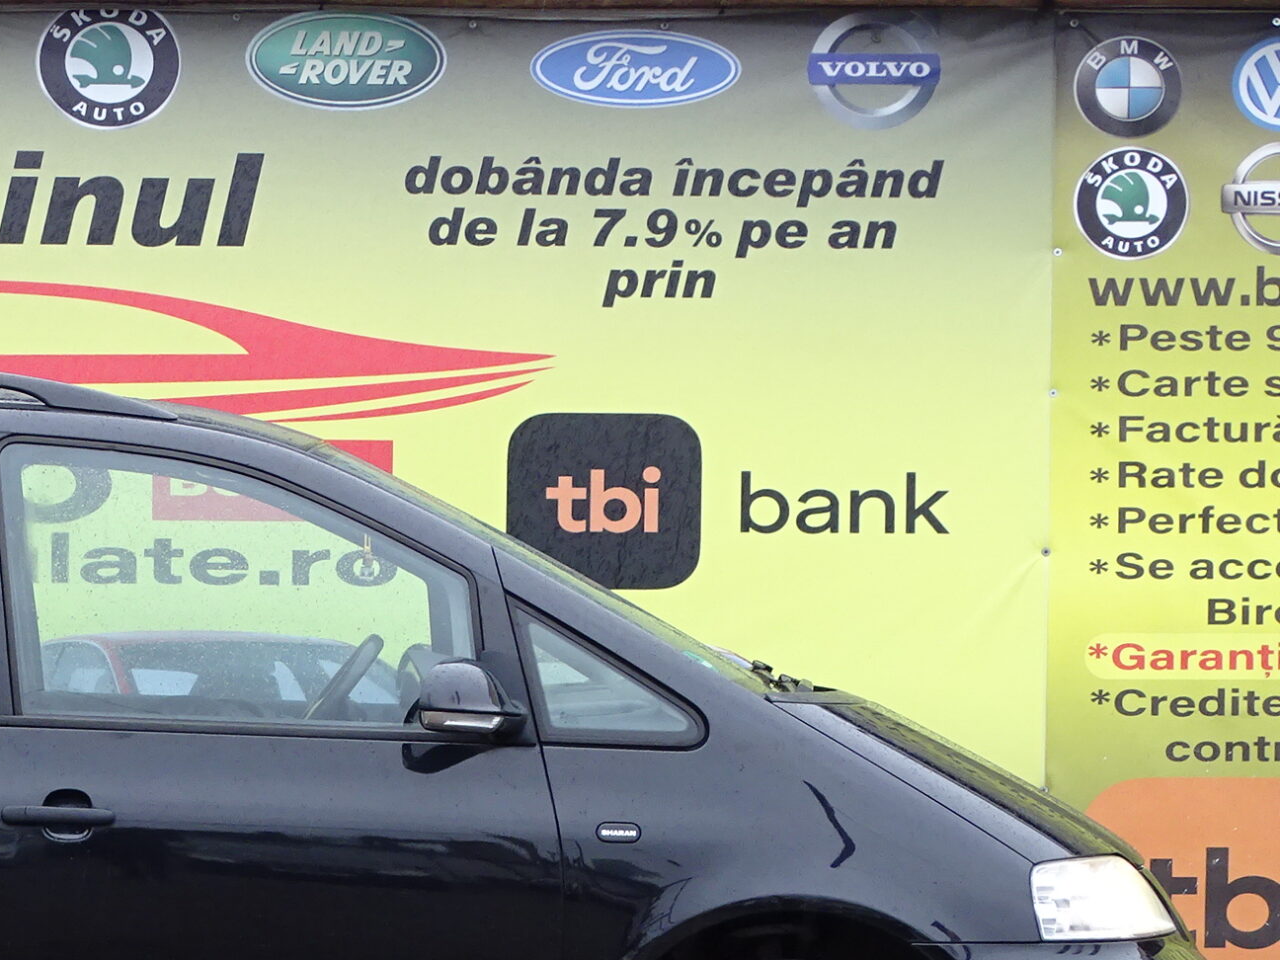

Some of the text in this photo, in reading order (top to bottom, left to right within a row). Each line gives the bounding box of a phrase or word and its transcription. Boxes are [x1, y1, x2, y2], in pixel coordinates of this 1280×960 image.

[291, 30, 376, 58] LAND
[1087, 40, 1173, 71] BMW
[298, 59, 412, 87] ROVER
[573, 42, 697, 94] Ford
[818, 60, 931, 78] VOLVO
[72, 101, 145, 121] AUTO
[404, 156, 945, 208] dobânda începând
[1234, 190, 1280, 207] NIS
[427, 207, 498, 247] de
[516, 208, 569, 247] la
[735, 217, 808, 258] pe
[827, 218, 898, 249] an
[1101, 236, 1160, 253] AUTO
[601, 260, 717, 307] prin
[546, 466, 950, 534] tbi bank
[1189, 558, 1280, 580] acc
[1207, 597, 1280, 625] Bir
[601, 829, 637, 837] SHARAN
